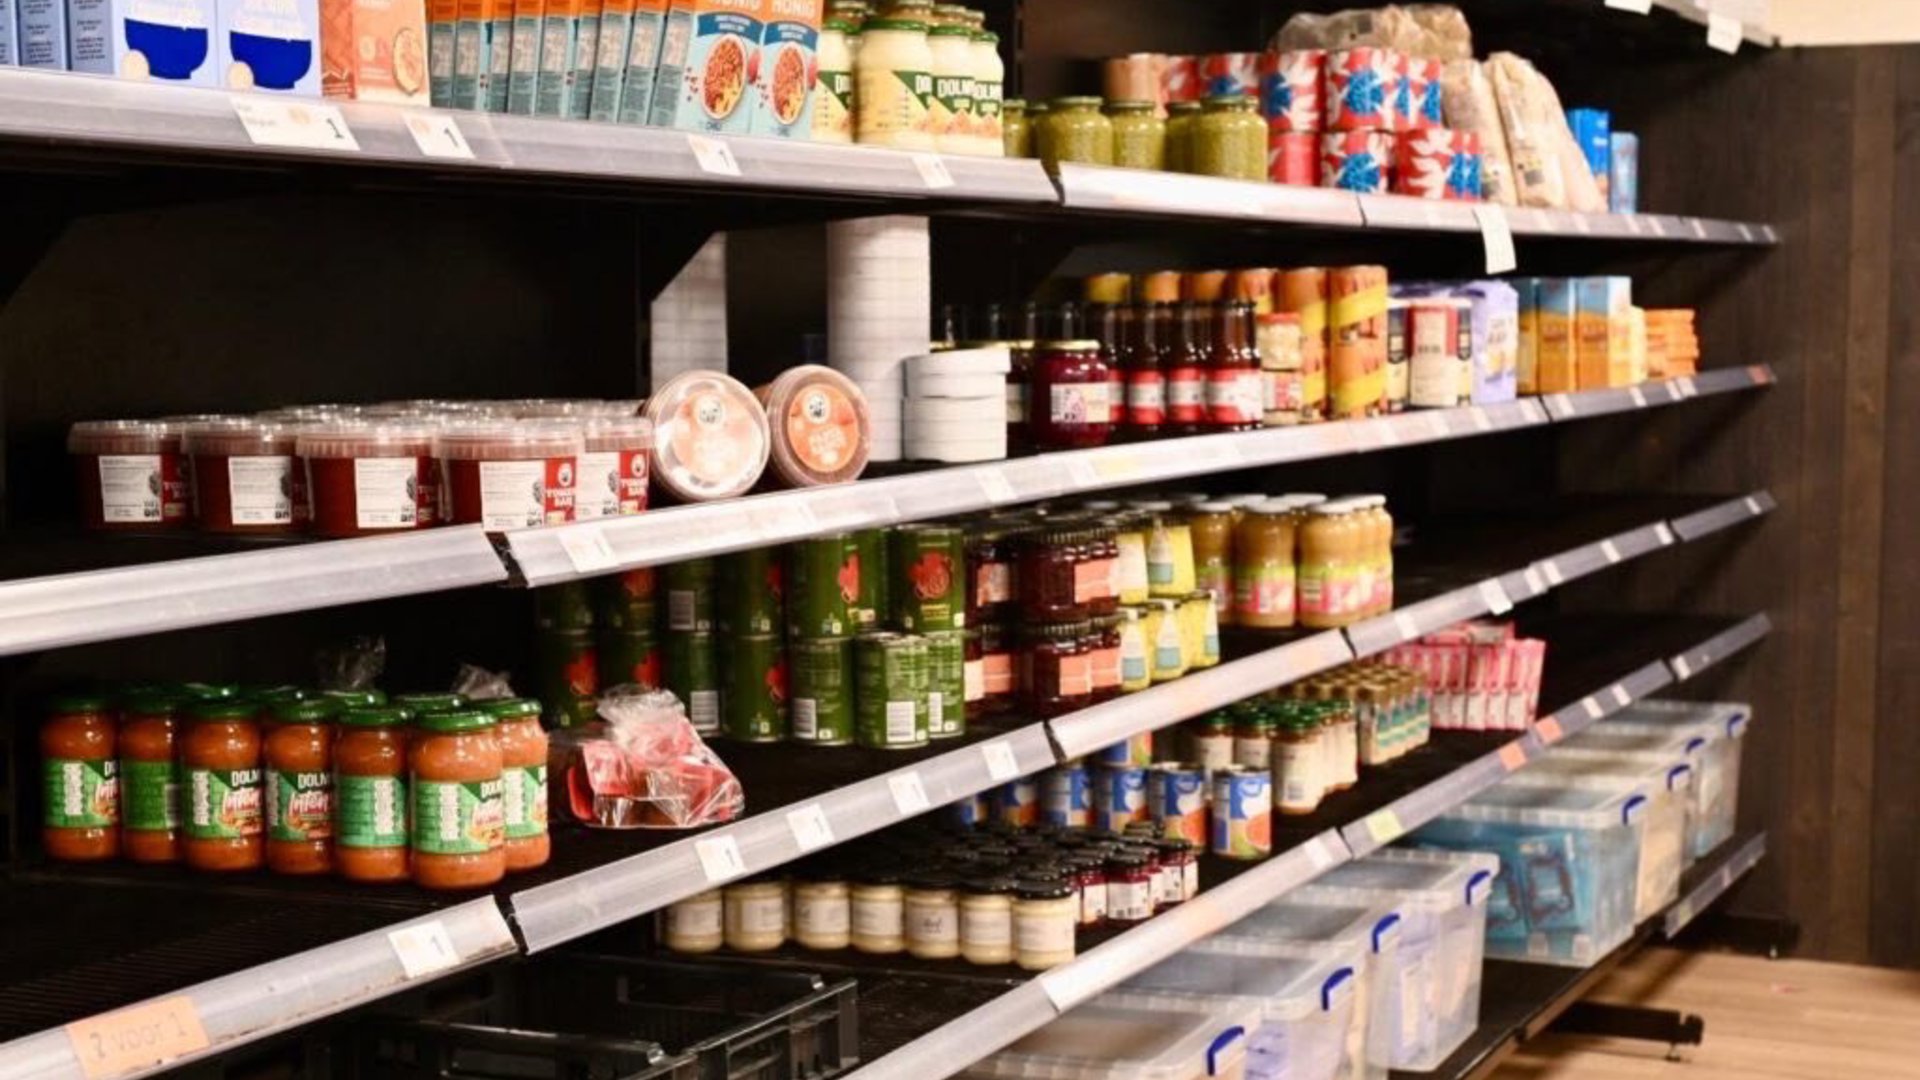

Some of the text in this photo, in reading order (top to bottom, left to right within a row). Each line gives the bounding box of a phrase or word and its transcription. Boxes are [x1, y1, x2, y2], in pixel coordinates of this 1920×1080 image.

[937, 78, 976, 99] DOLM
[325, 117, 344, 139] 1
[443, 127, 459, 148] 1
[231, 769, 261, 788] DOLM
[297, 772, 330, 790] DOLM
[430, 935, 446, 956] 1
[170, 1011, 187, 1037] 1
